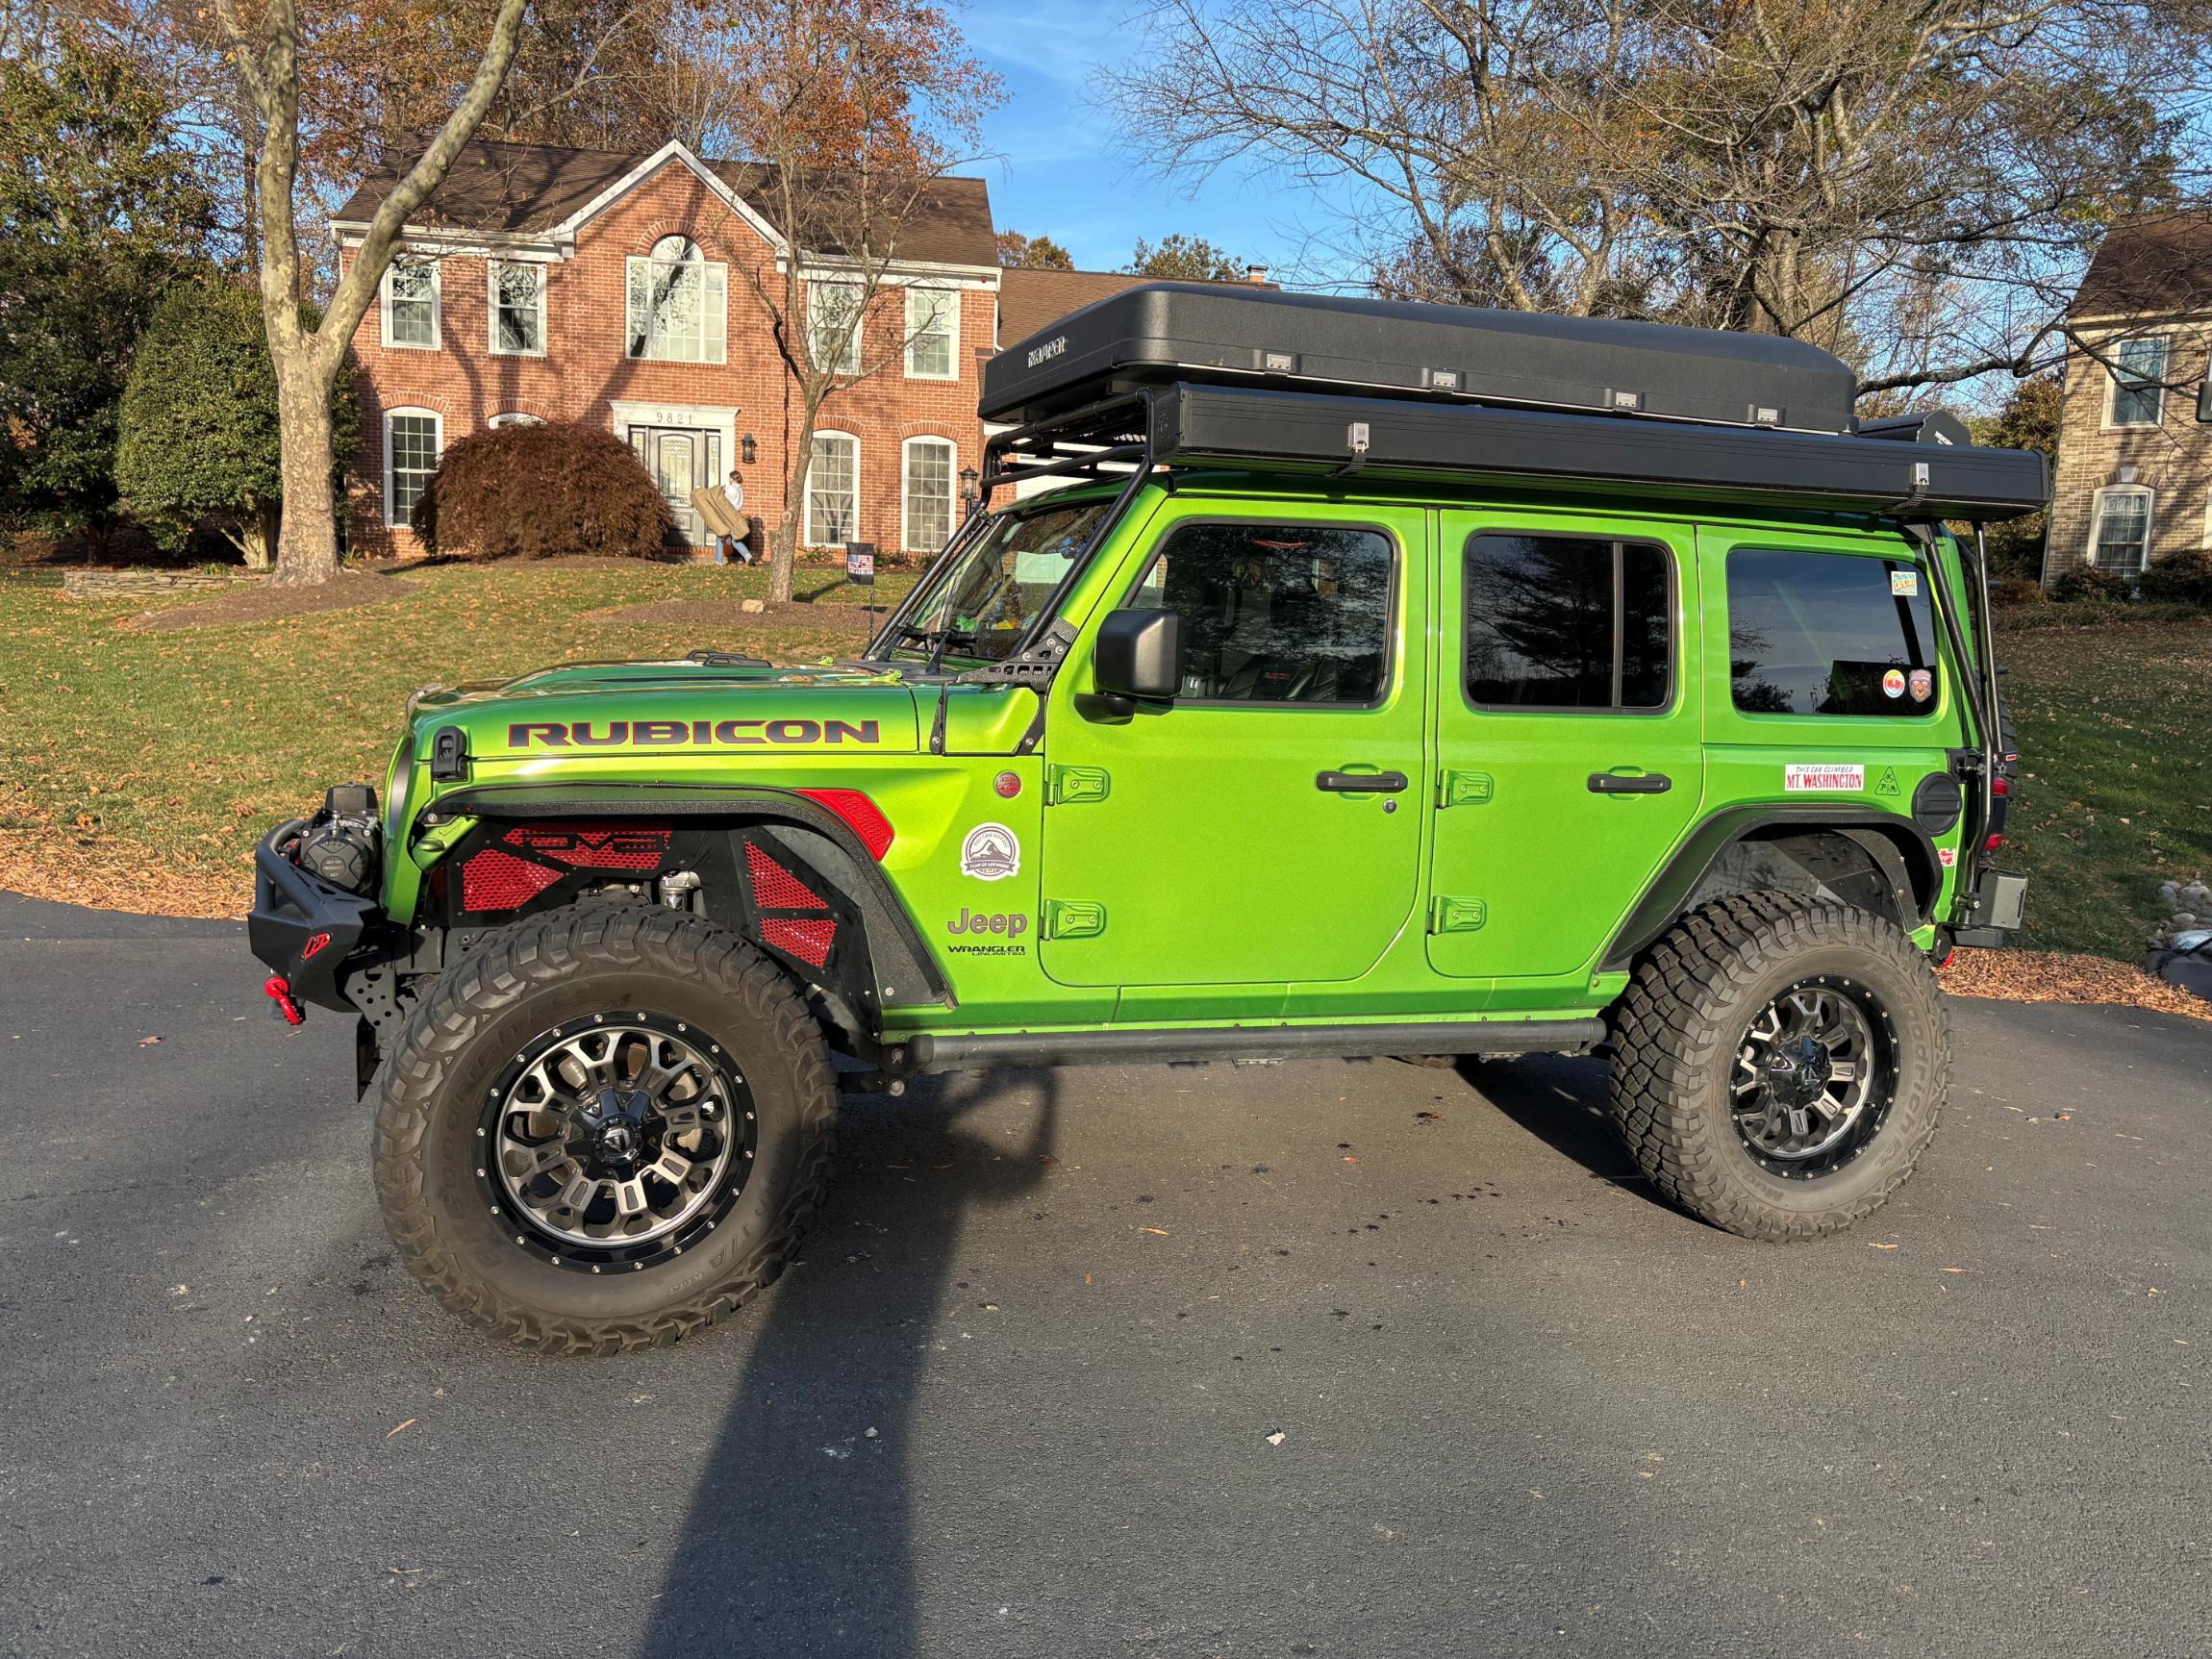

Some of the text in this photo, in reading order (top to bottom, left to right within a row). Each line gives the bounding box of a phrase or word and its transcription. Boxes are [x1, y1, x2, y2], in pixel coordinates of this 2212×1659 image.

[656, 413, 692, 425] 9821
[508, 719, 880, 747] RUBICON
[1787, 773, 1862, 789] MT. WASHINGTON
[947, 908, 1028, 939] Jeep
